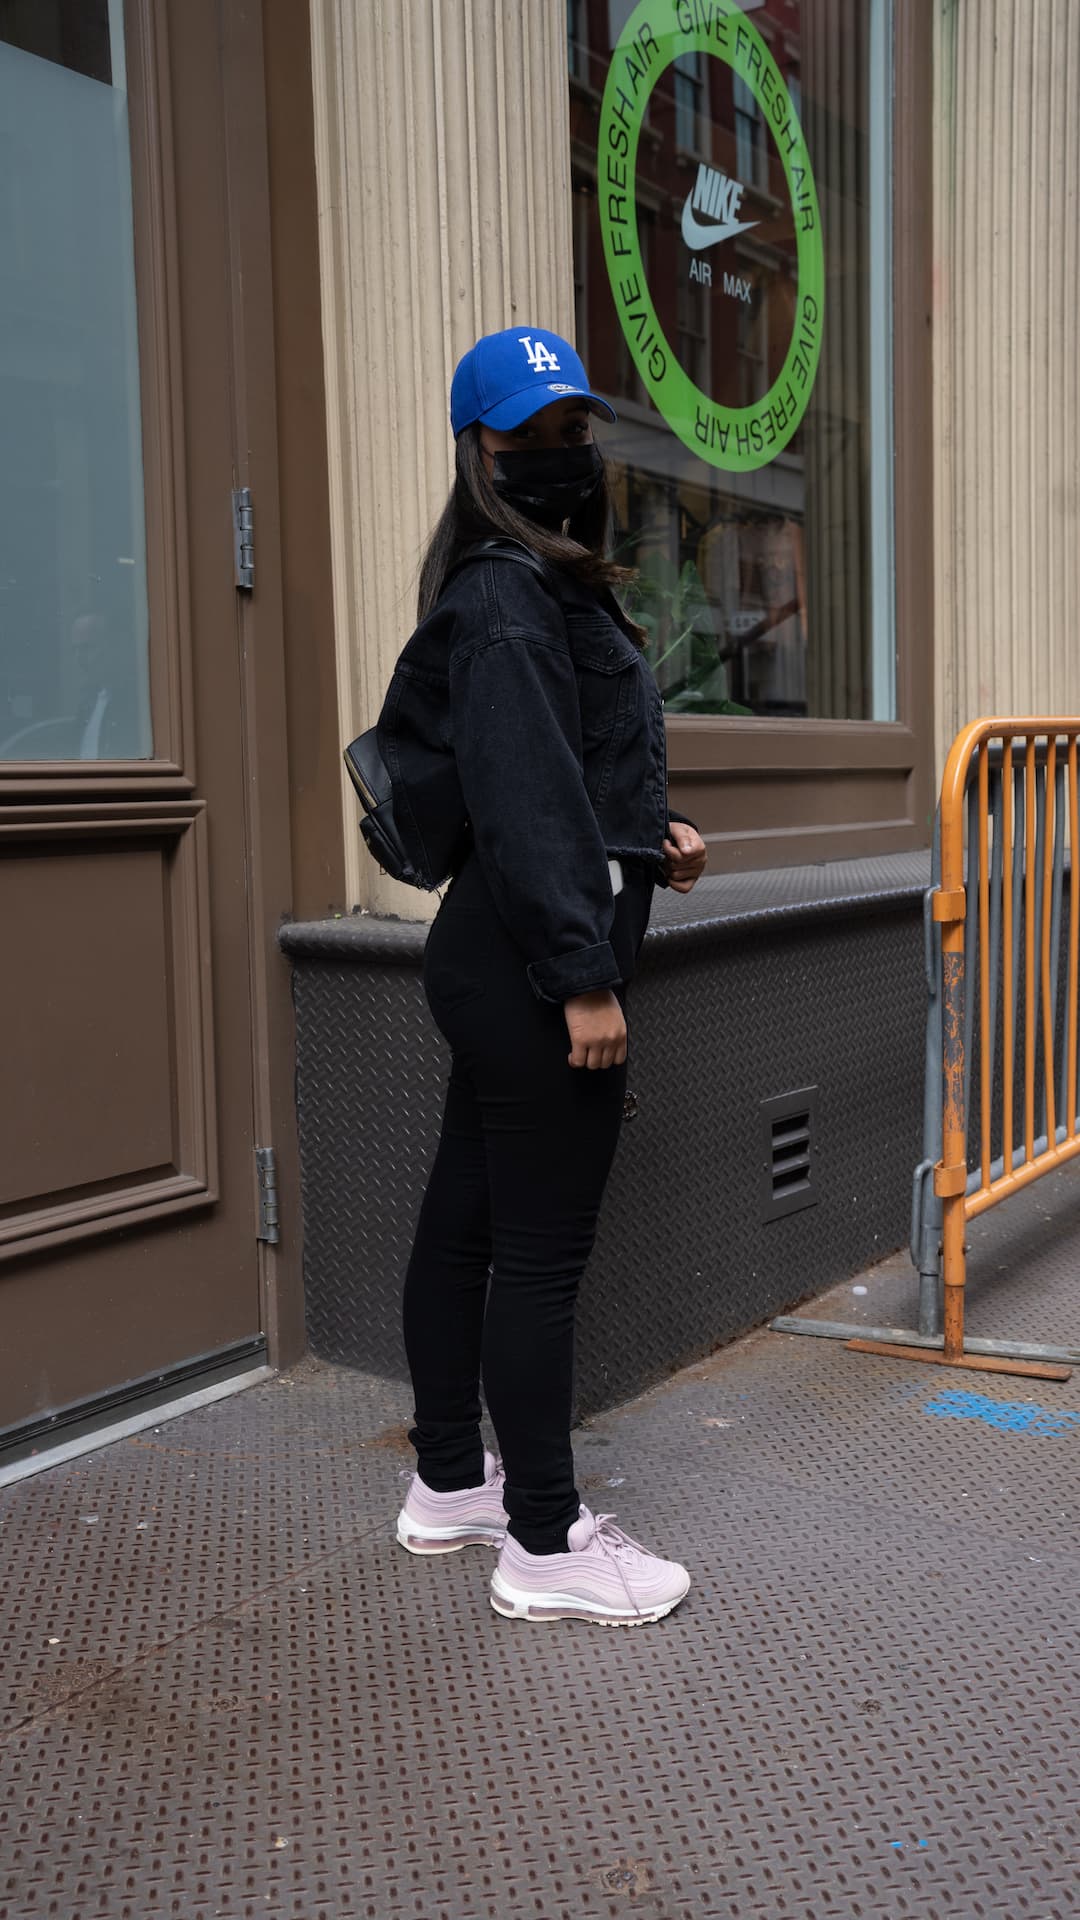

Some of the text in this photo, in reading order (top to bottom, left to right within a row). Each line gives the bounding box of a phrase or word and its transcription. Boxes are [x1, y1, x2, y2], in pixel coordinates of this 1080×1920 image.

[676, 0, 815, 232] GIVE FRESH AIR
[607, 22, 667, 383] GIVE FRESH AIR
[692, 163, 744, 225] NIKE
[689, 257, 752, 304] AIR MAX
[518, 335, 561, 373] LA
[694, 294, 818, 456] GIVE FRESH AIR
